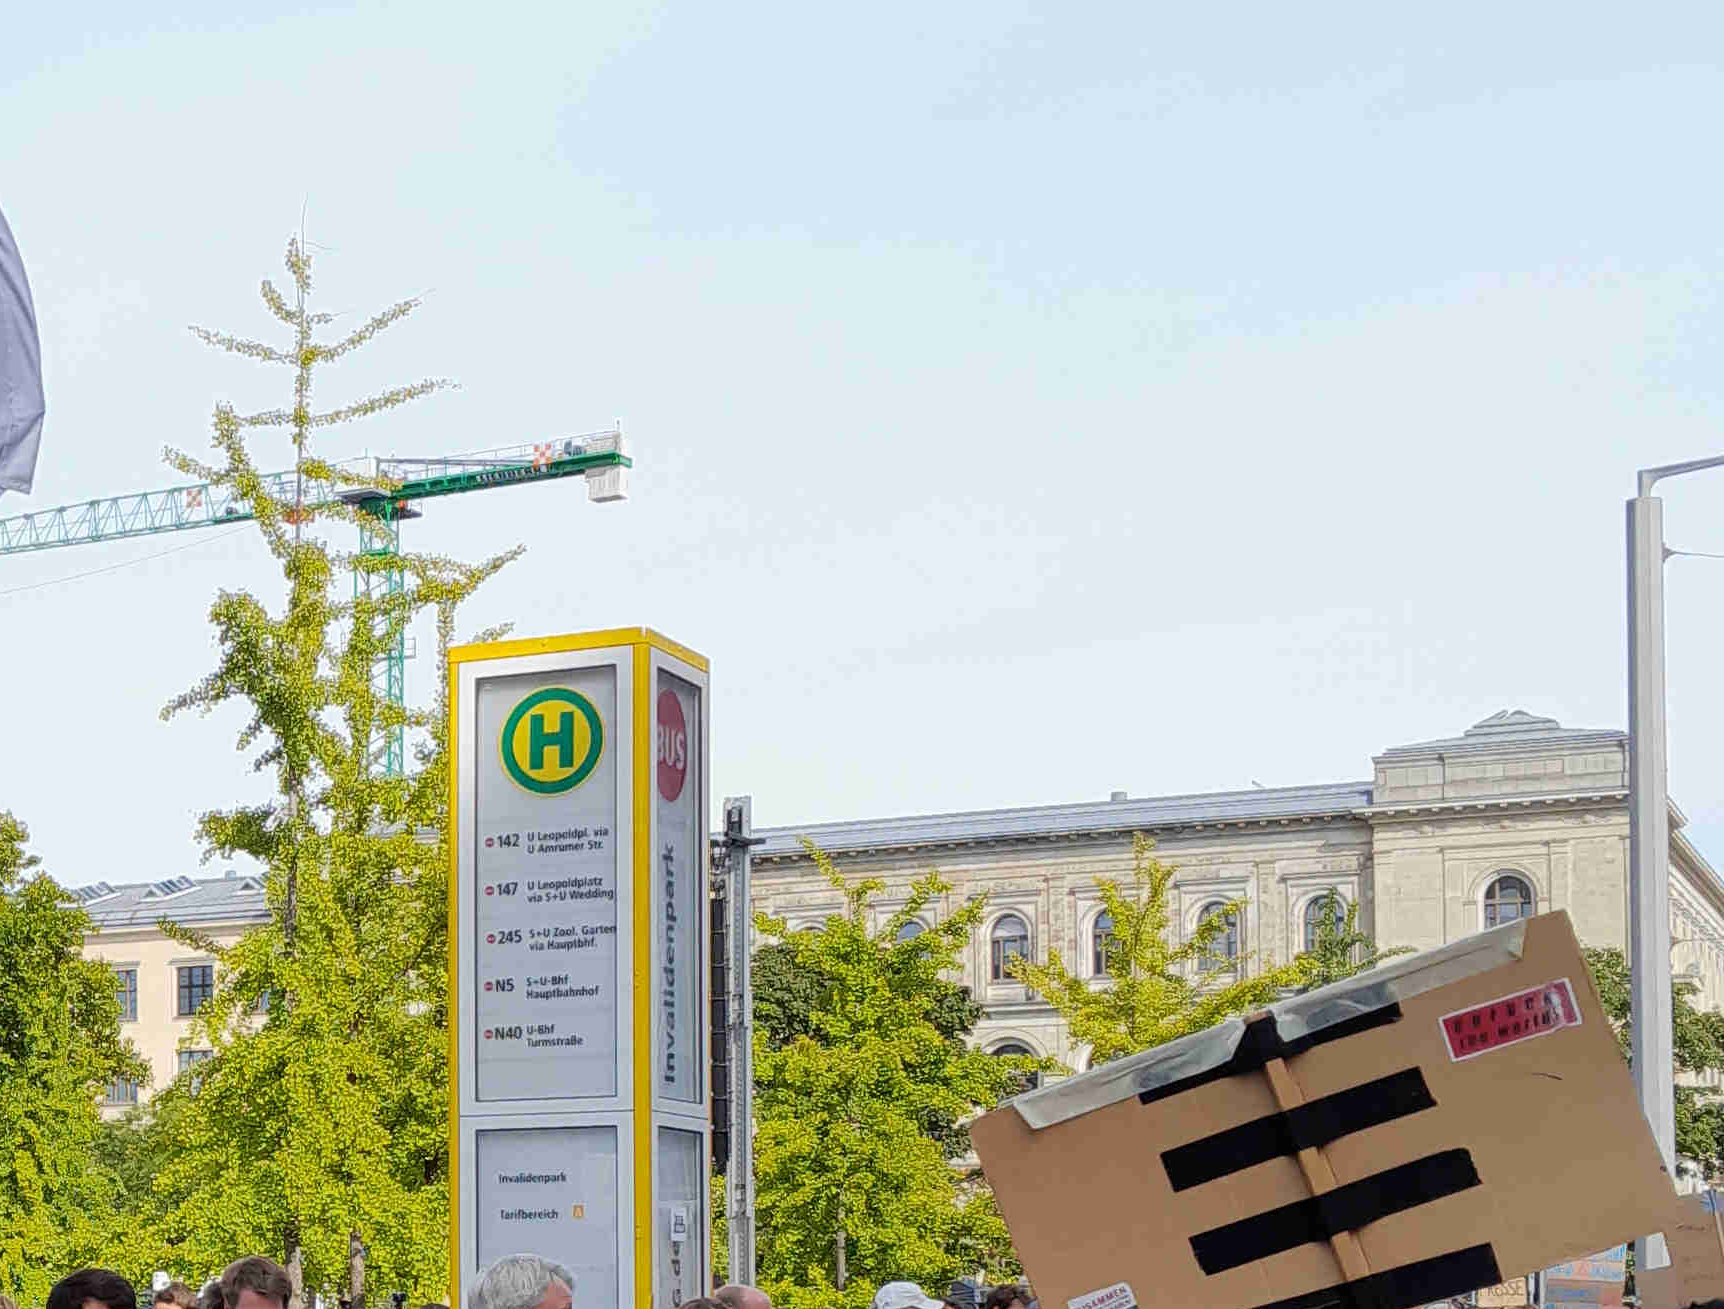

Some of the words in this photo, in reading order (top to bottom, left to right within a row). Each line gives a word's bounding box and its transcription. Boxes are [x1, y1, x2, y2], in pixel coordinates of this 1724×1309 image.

[529, 711, 575, 771] H
[657, 723, 685, 769] BUS
[497, 833, 520, 848] 142
[527, 832, 534, 841] U
[537, 828, 588, 841] Leopoldpl.
[594, 827, 609, 837] via
[527, 845, 535, 854] U
[537, 843, 584, 853] Amrumer
[588, 840, 604, 850] Str.
[497, 882, 518, 896] 147
[527, 881, 534, 890] U
[537, 877, 603, 891] Leopoldplatz
[527, 893, 542, 902] via
[545, 891, 567, 901] S+U
[569, 888, 614, 899] Wedding
[497, 929, 522, 944] 245
[529, 928, 550, 938] S+U
[553, 926, 578, 937] Zool.
[581, 924, 616, 935] Garten
[529, 941, 544, 951] via
[663, 844, 676, 1083] Invalidenpark
[495, 978, 515, 992] N5
[526, 985, 599, 1000] Hauptbahnhof
[494, 1026, 523, 1040] N40
[526, 1036, 583, 1047] Turmstraße
[498, 1171, 567, 1184] Invalidenpark
[500, 1208, 559, 1220] Tarifbereich
